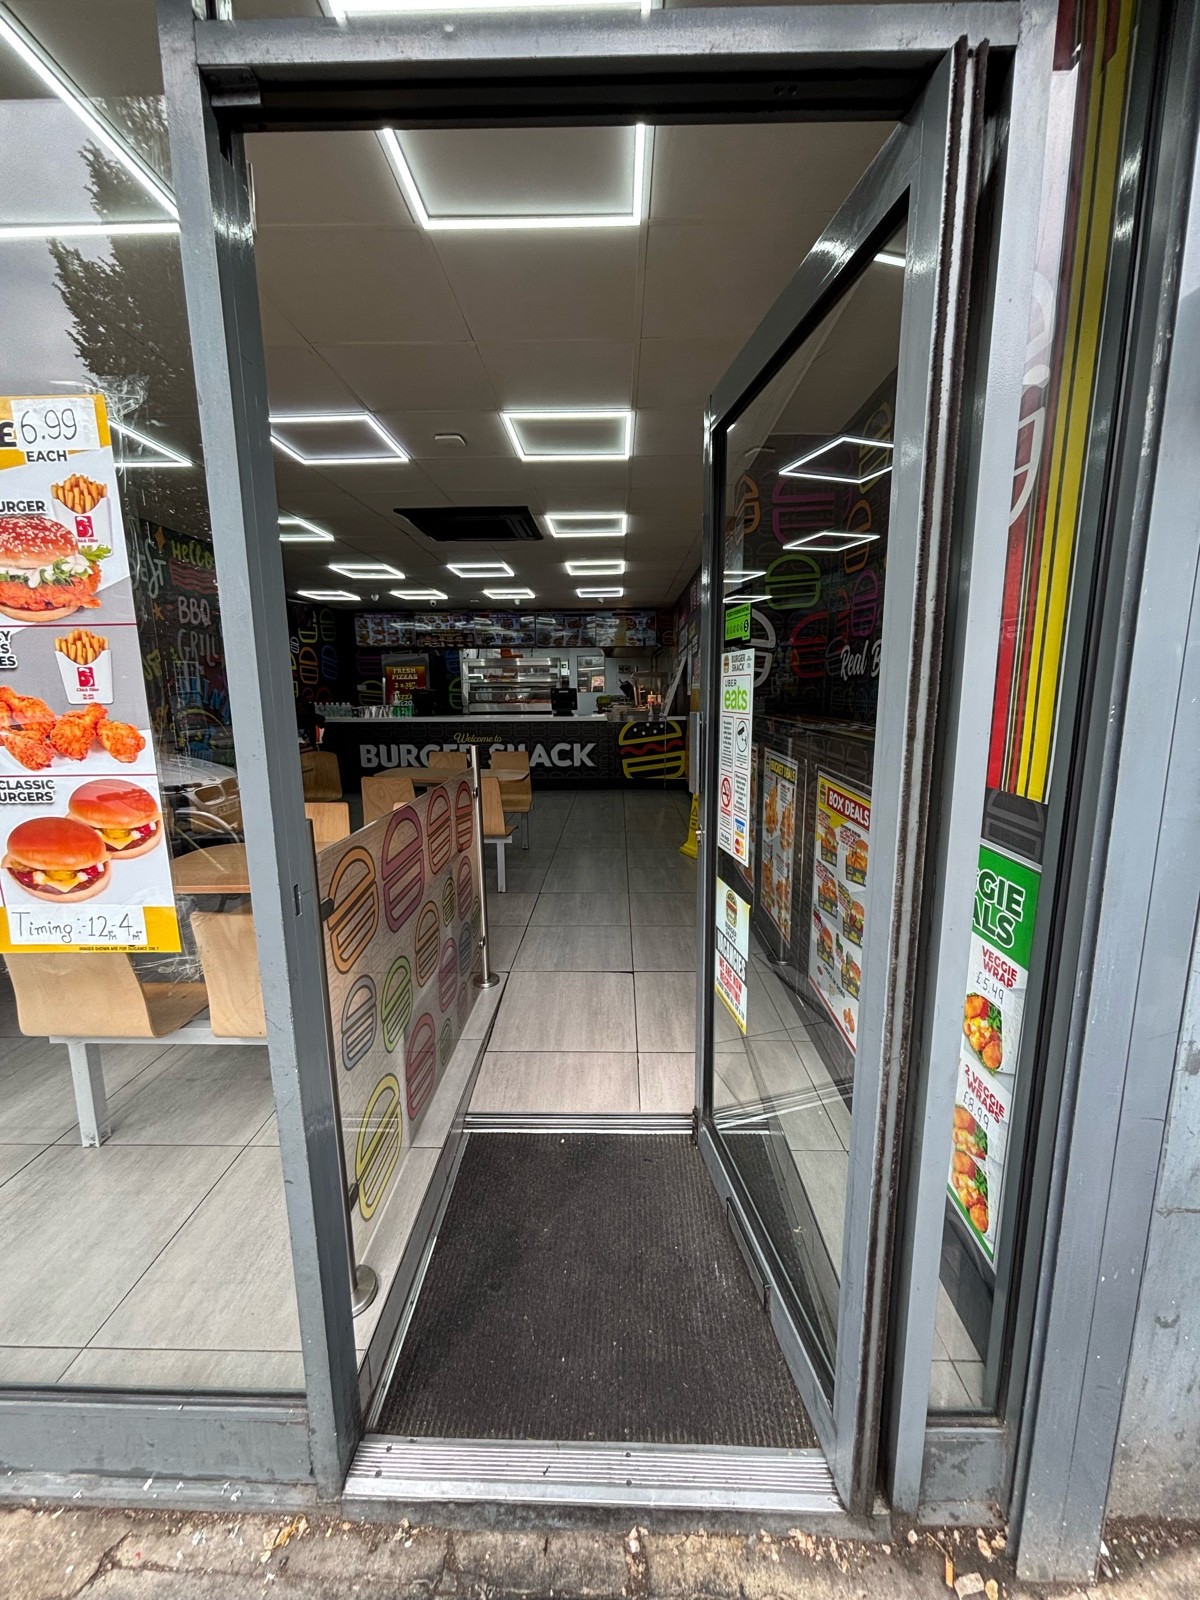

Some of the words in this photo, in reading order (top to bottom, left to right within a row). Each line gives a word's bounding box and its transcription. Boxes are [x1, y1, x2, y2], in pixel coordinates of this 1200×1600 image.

[20, 408, 77, 444] 6.99
[26, 450, 68, 462] EACH
[177, 596, 212, 627] BBQ
[0, 631, 10, 641] Y
[393, 666, 416, 674] FRESH
[840, 640, 869, 682] Real
[724, 686, 748, 710] eats
[725, 679, 737, 687] UBER
[453, 732, 493, 744] Welcome
[494, 734, 503, 744] to
[359, 743, 474, 768] BURG
[0, 780, 56, 790] CLASSIC
[828, 790, 844, 812] BOX
[845, 799, 870, 827] DEALS
[977, 868, 1026, 923] GIE
[11, 911, 73, 944] Timing
[981, 944, 1018, 982] VEGGIE
[982, 958, 1014, 989] WRAP
[975, 971, 1005, 1004] £5.49
[964, 1063, 971, 1077] 2
[972, 1071, 1006, 1119] VEGGIE
[966, 1077, 1001, 1125] WRAPS
[963, 1091, 990, 1131] £8.99
